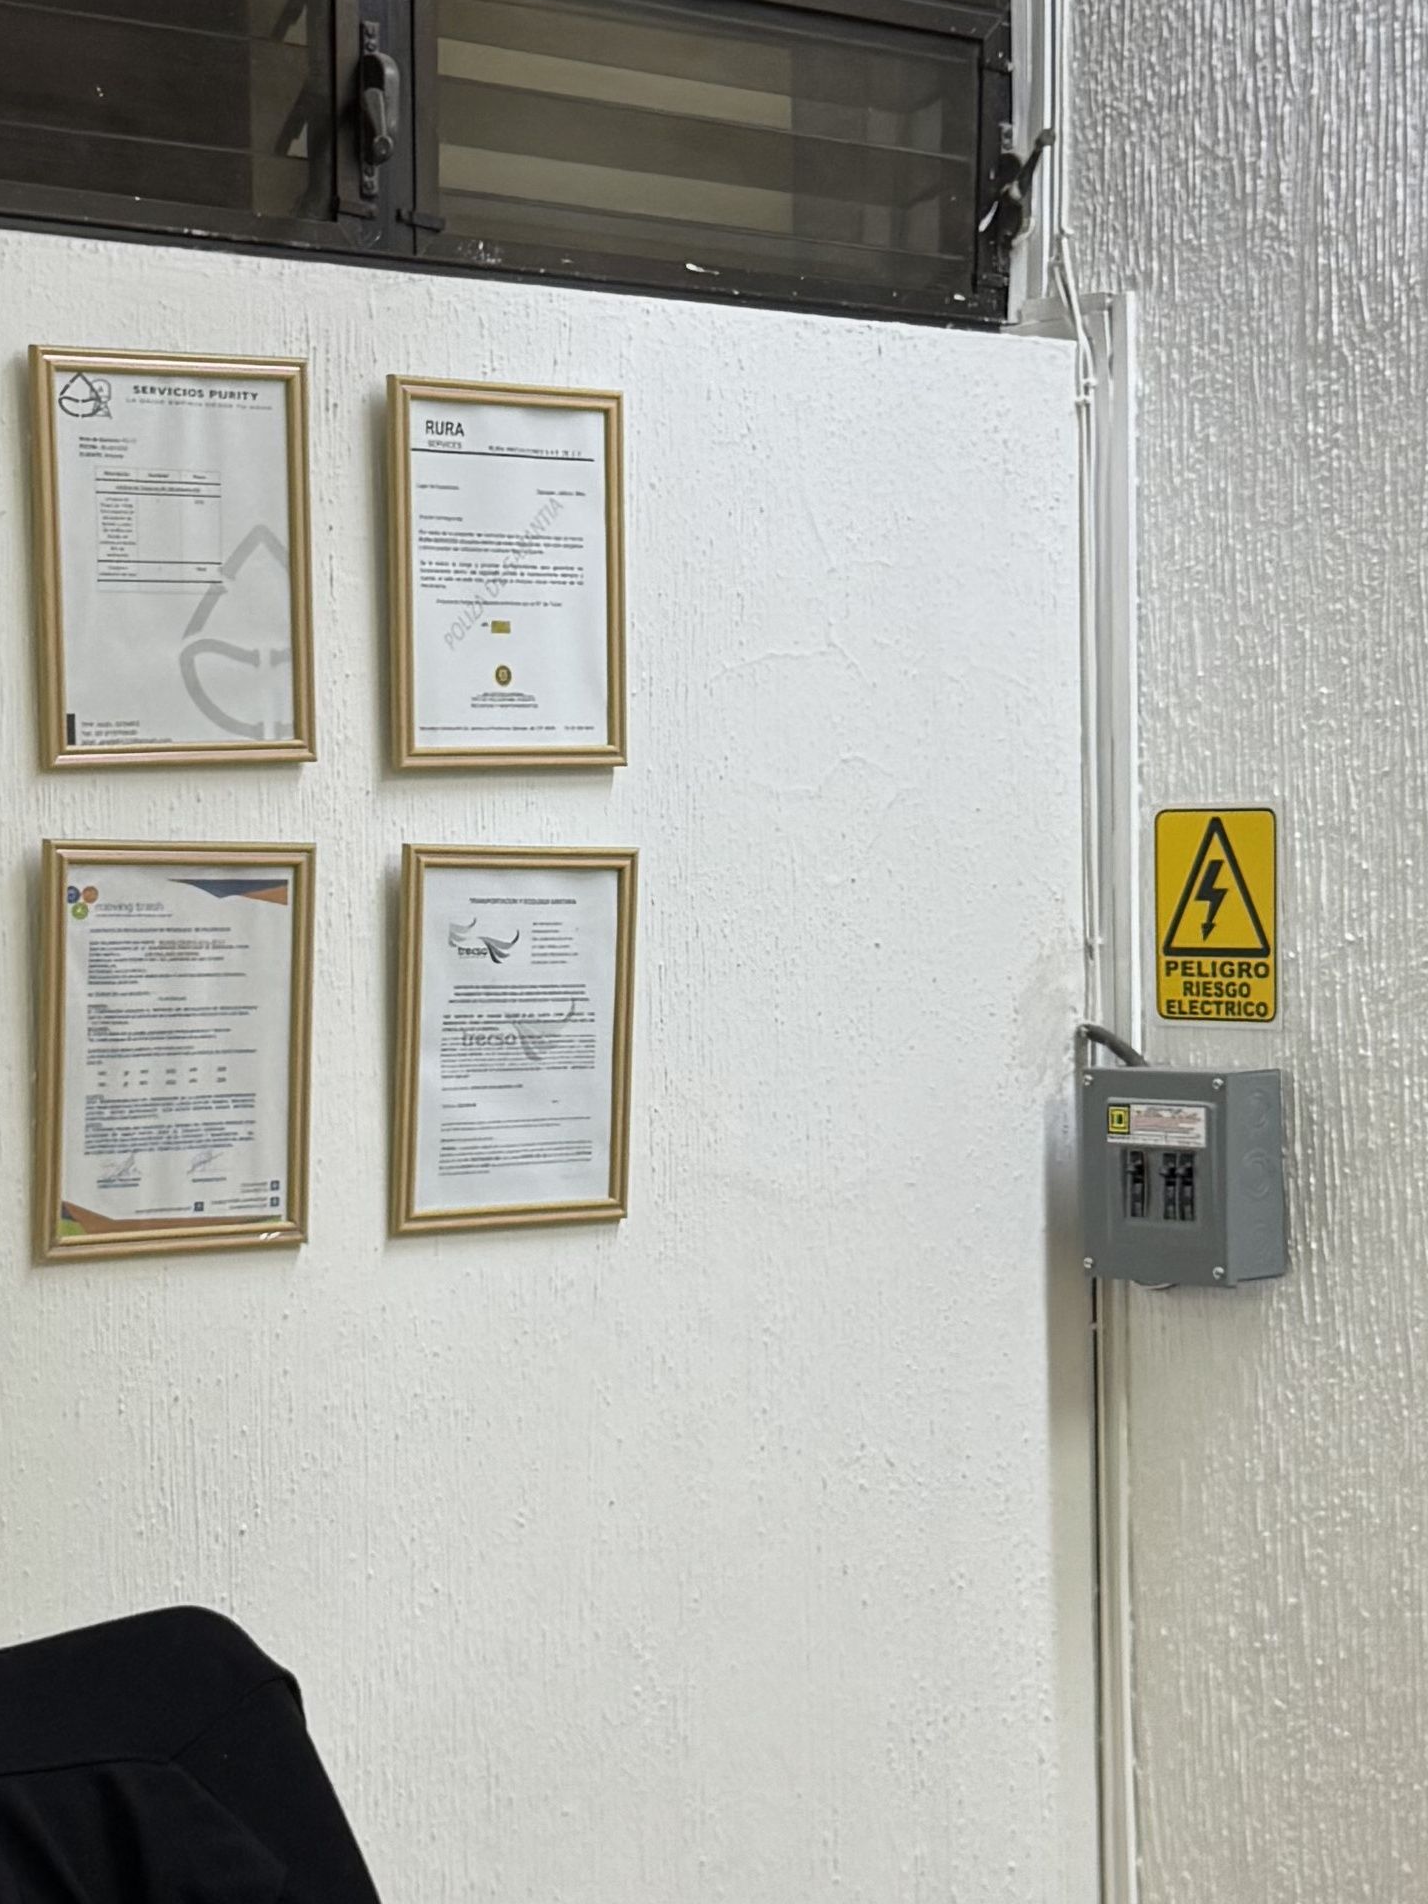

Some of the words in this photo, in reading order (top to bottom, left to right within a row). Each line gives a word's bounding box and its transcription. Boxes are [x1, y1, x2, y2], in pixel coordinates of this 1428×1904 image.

[132, 385, 205, 399] SERVICIOS
[209, 389, 259, 401] PURITY
[425, 419, 465, 437] RURA
[427, 439, 462, 449] SERVICES
[1165, 960, 1270, 978] PELIGRO
[1183, 981, 1251, 998] RIESGO
[1166, 999, 1269, 1017] ELECTRICO
